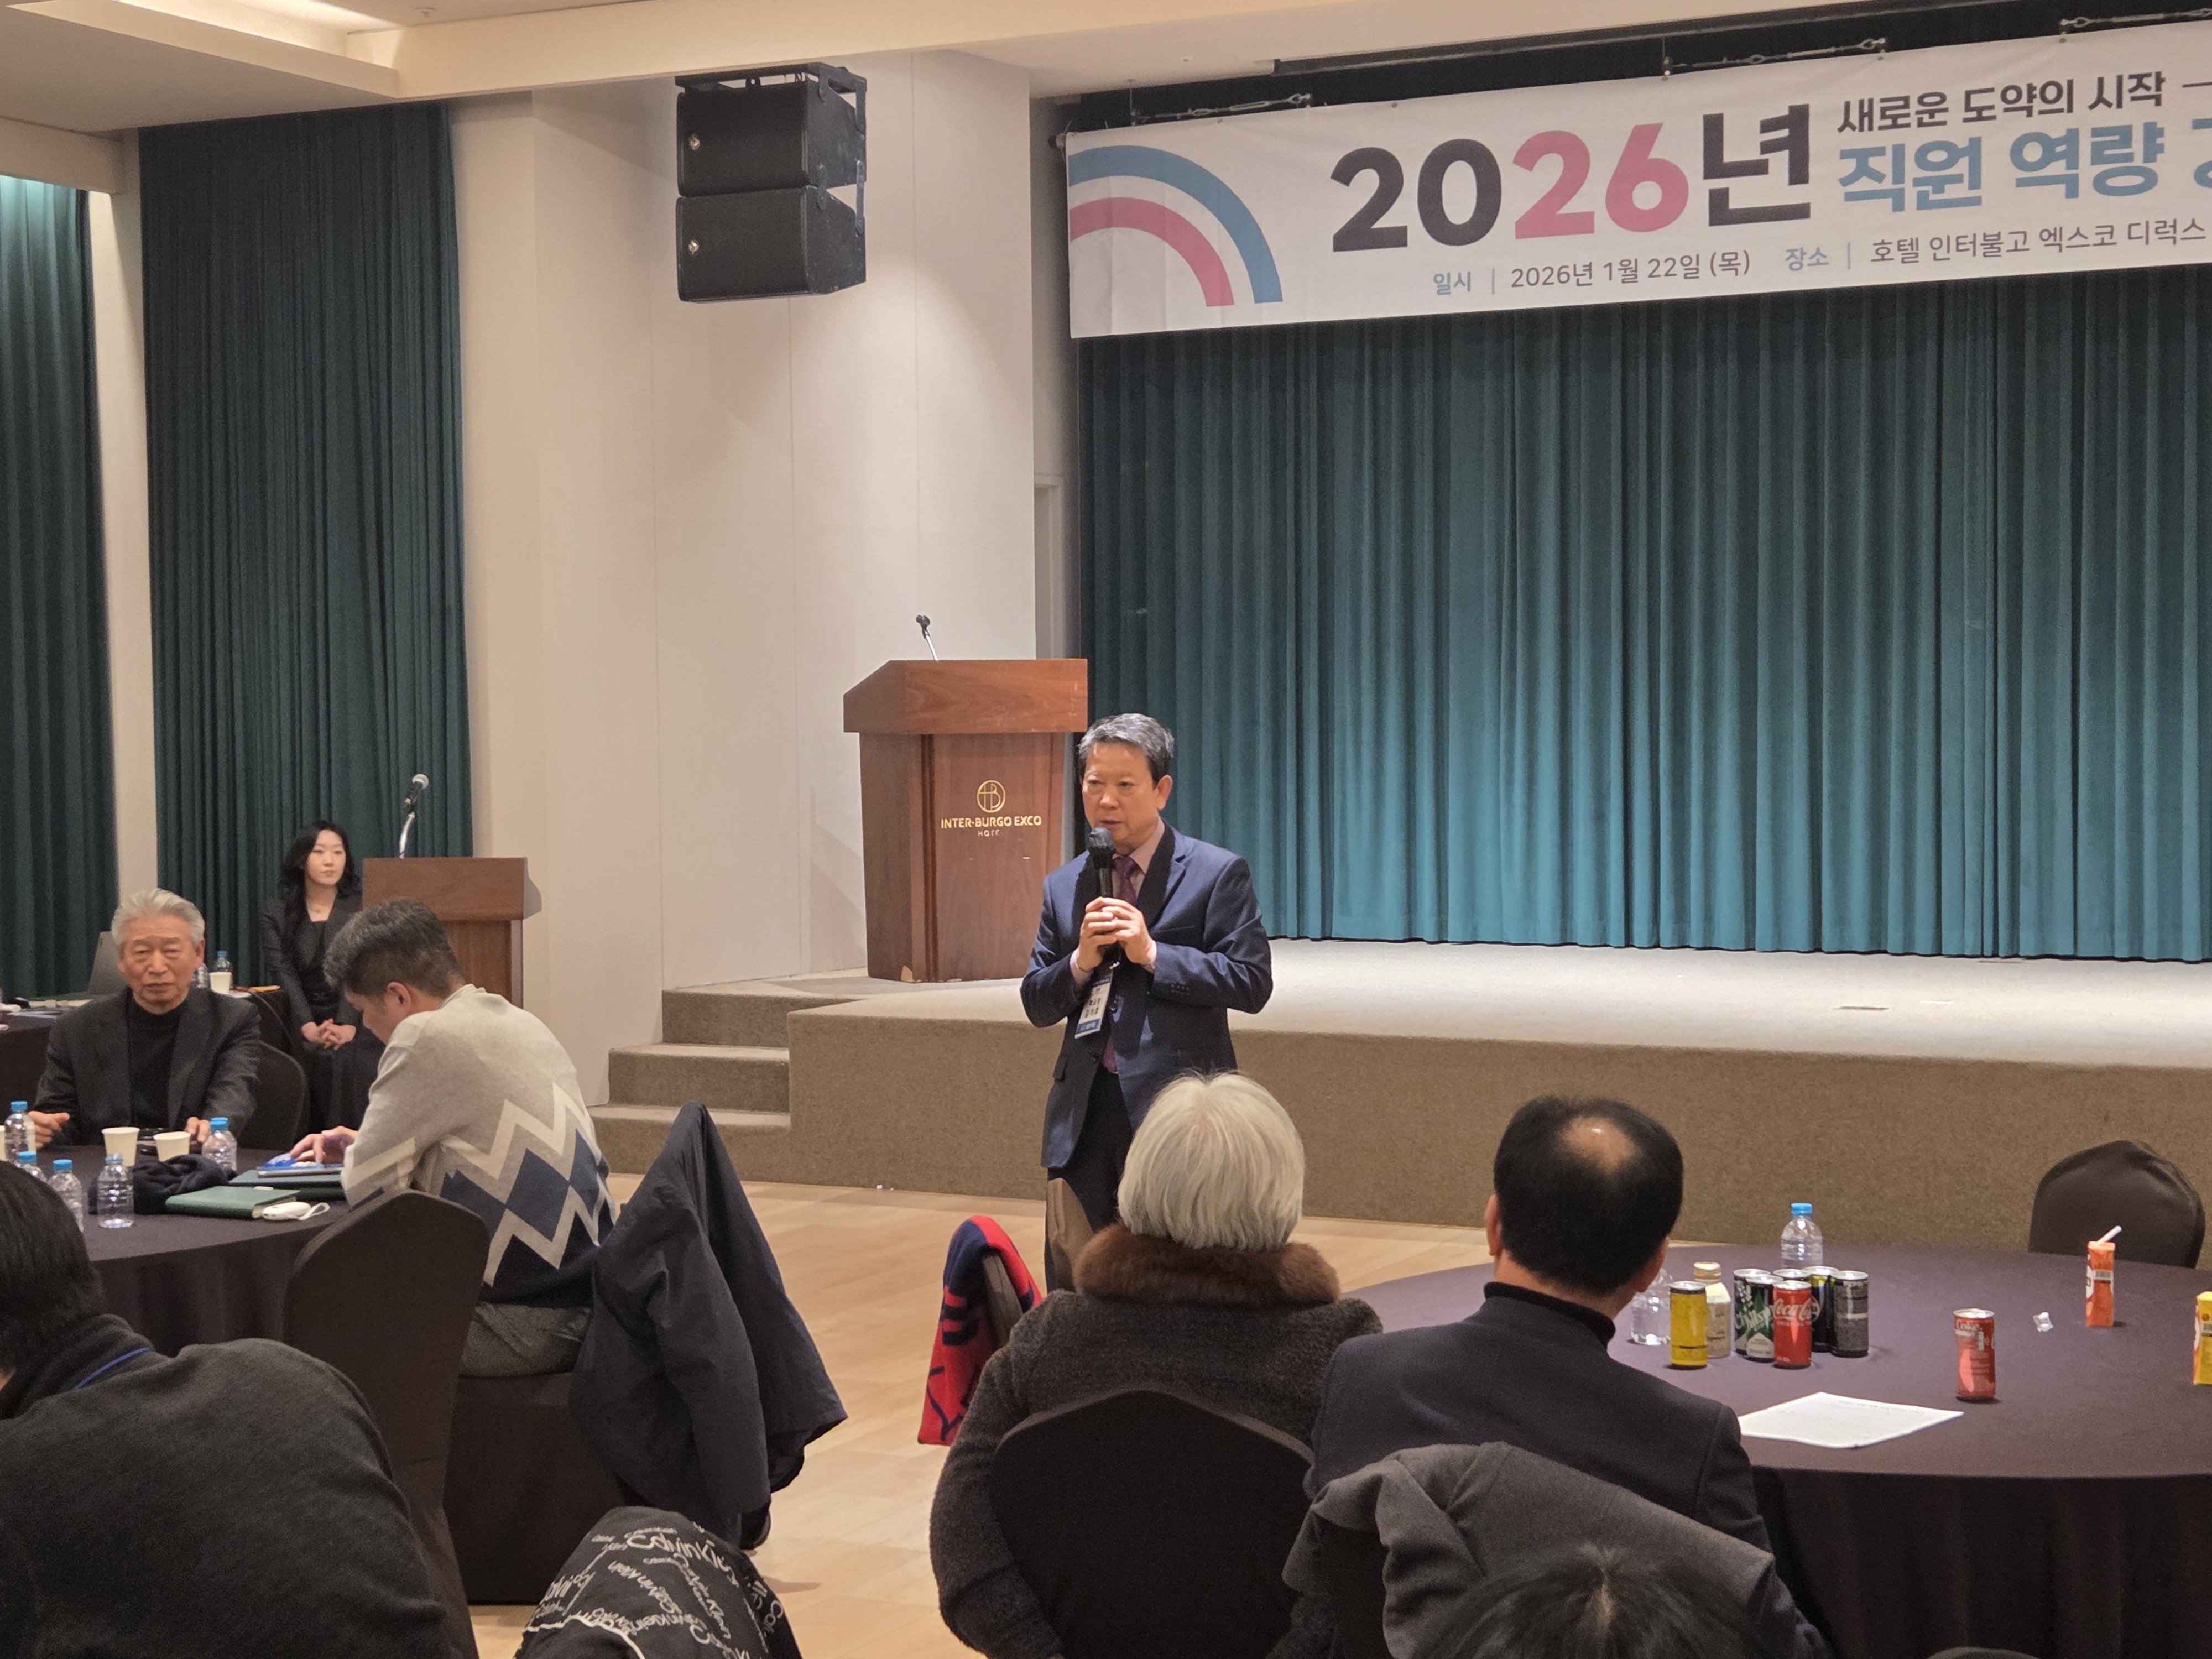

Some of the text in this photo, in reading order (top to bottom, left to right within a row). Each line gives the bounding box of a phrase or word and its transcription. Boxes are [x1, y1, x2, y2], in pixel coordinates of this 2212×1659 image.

[1837, 71, 2166, 133] 새로운 도약의 시작
[1330, 105, 1811, 252] 2026년
[1838, 137, 1982, 212] 직원
[2009, 121, 2165, 198] 역량
[1433, 218, 2206, 296] 일시 2026년 1월 22일 (목) 장소 호텔 인터불고 엑스코 디럭스
[941, 815, 1042, 829] INTER-BURGO EXCO
